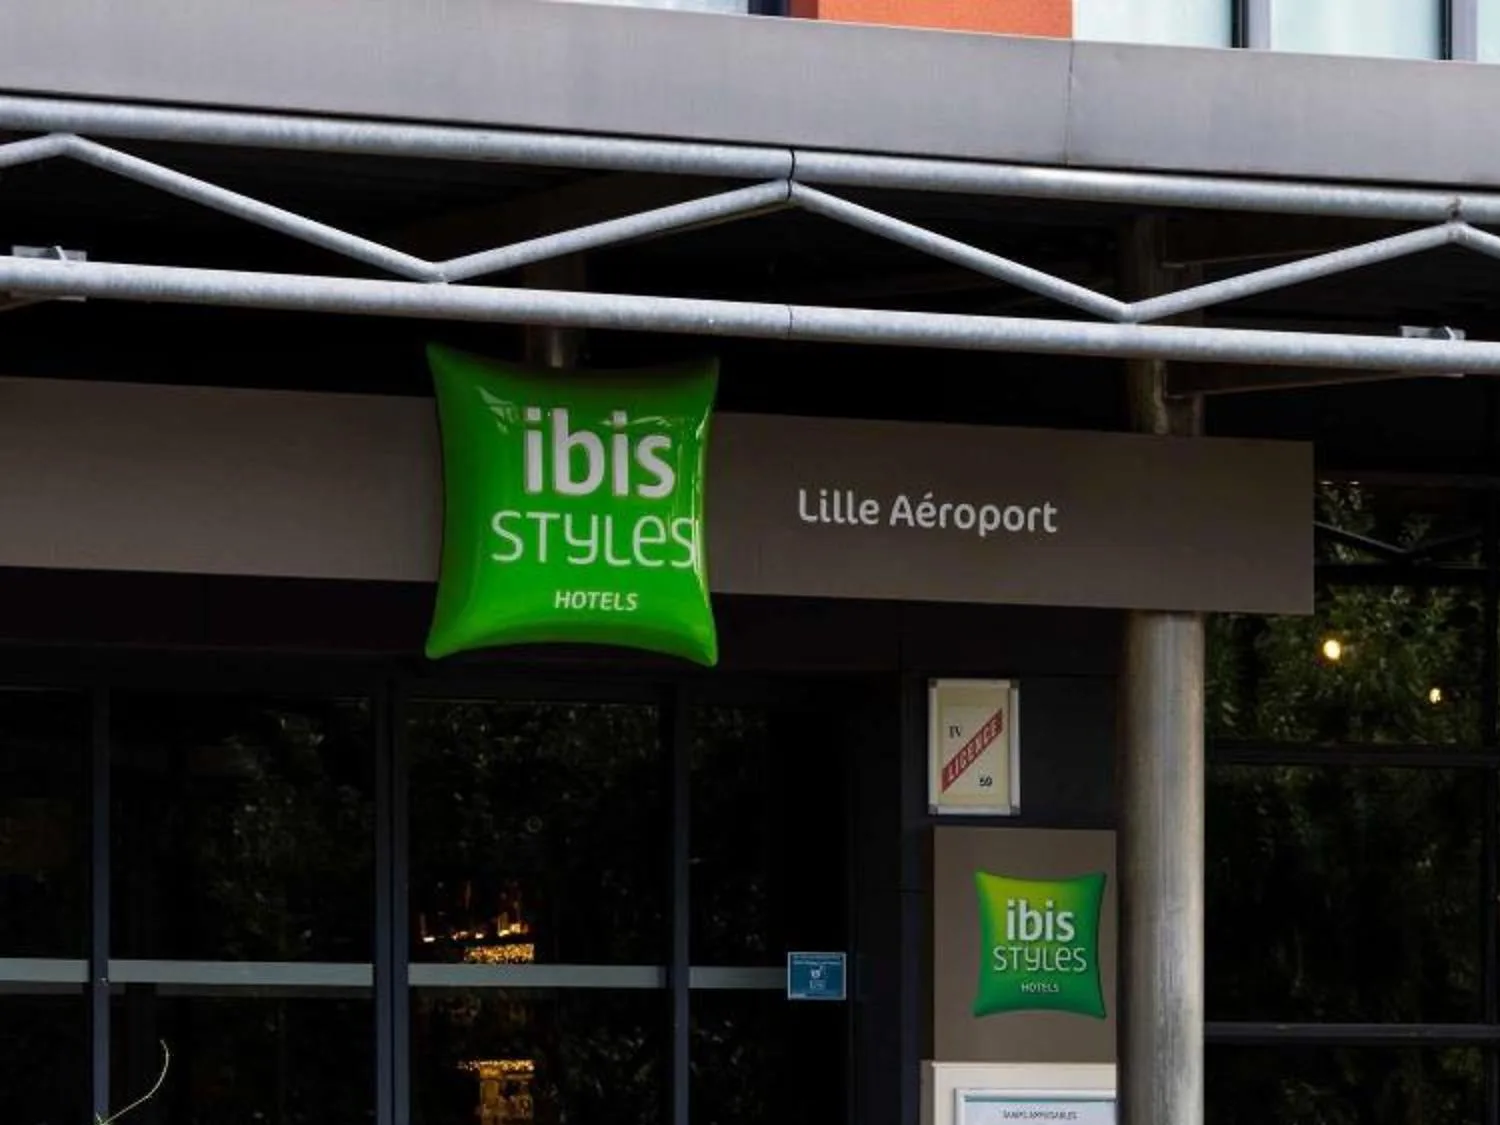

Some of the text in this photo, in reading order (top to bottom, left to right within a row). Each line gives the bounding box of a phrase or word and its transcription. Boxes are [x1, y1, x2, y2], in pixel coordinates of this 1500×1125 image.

[526, 406, 675, 498] ibis
[799, 488, 1058, 537] Lille Aéroport
[554, 590, 639, 611] HOTELS
[1006, 899, 1075, 942] ibis
[1020, 982, 1060, 993] HOTELS
